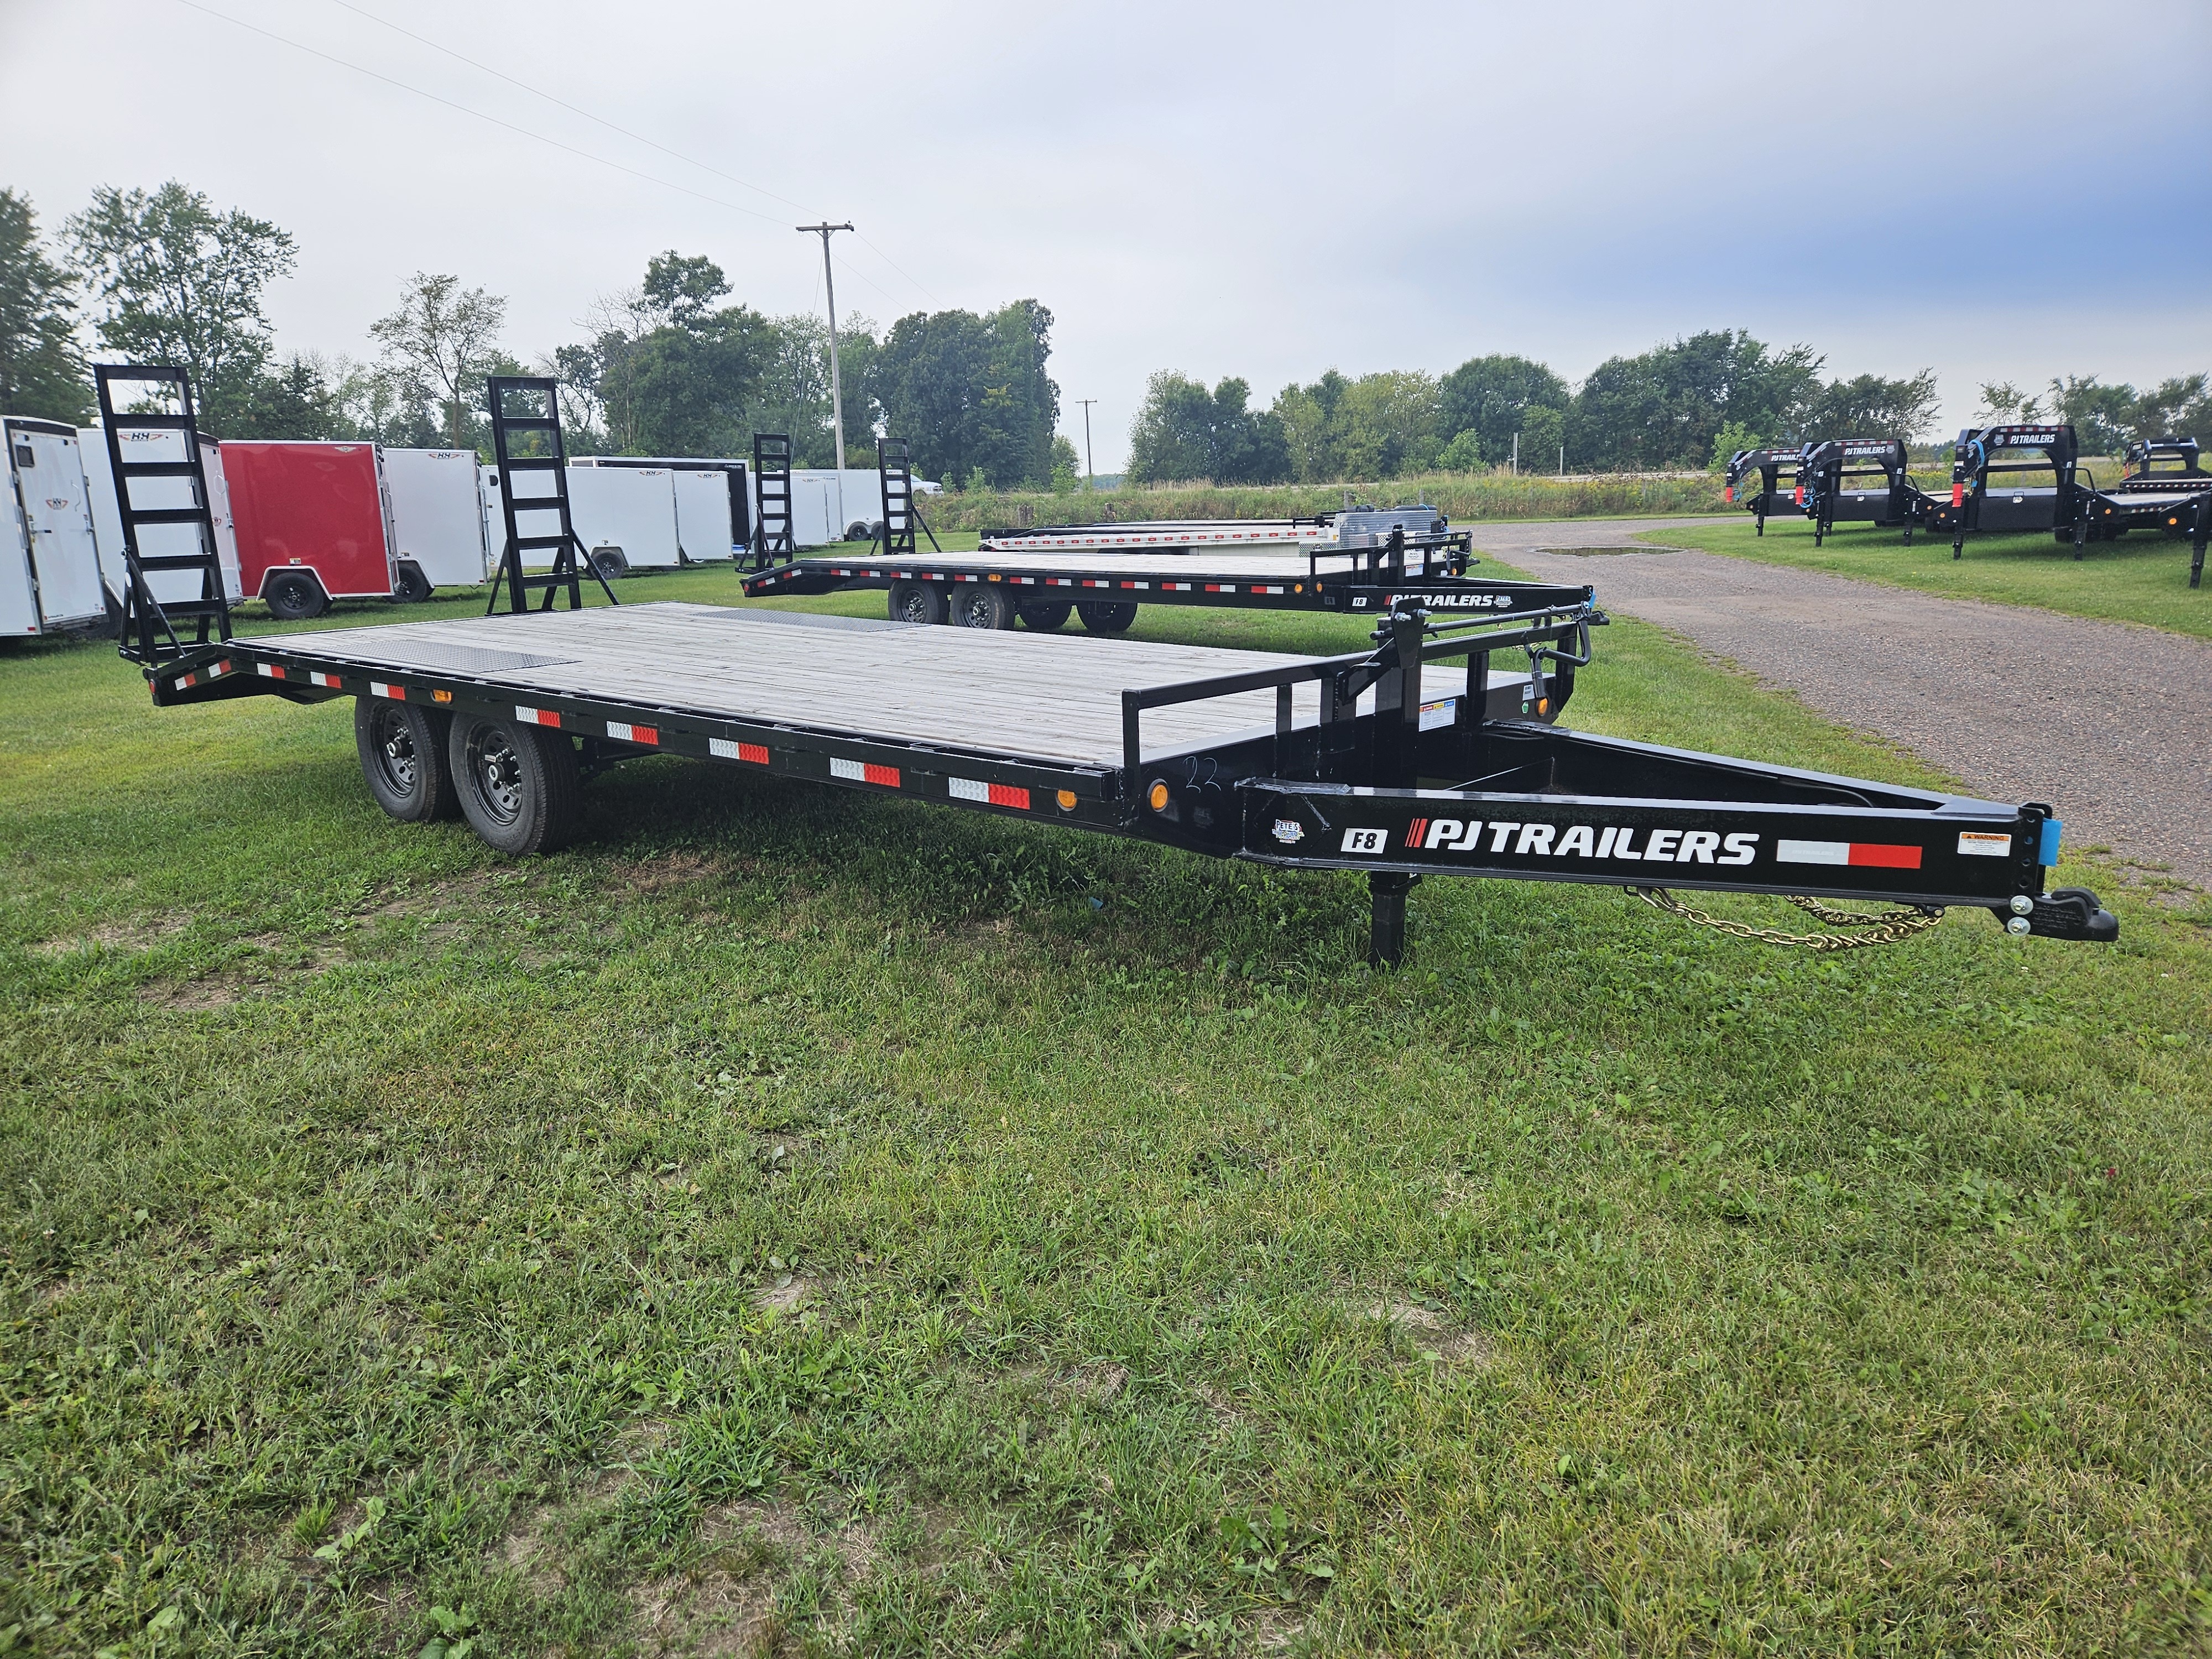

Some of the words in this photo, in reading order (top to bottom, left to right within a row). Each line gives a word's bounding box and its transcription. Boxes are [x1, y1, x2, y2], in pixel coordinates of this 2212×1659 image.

[1276, 820, 1298, 831] PETE'S
[1352, 832, 1378, 849] F8
[1488, 822, 1760, 865] TRAILERS
